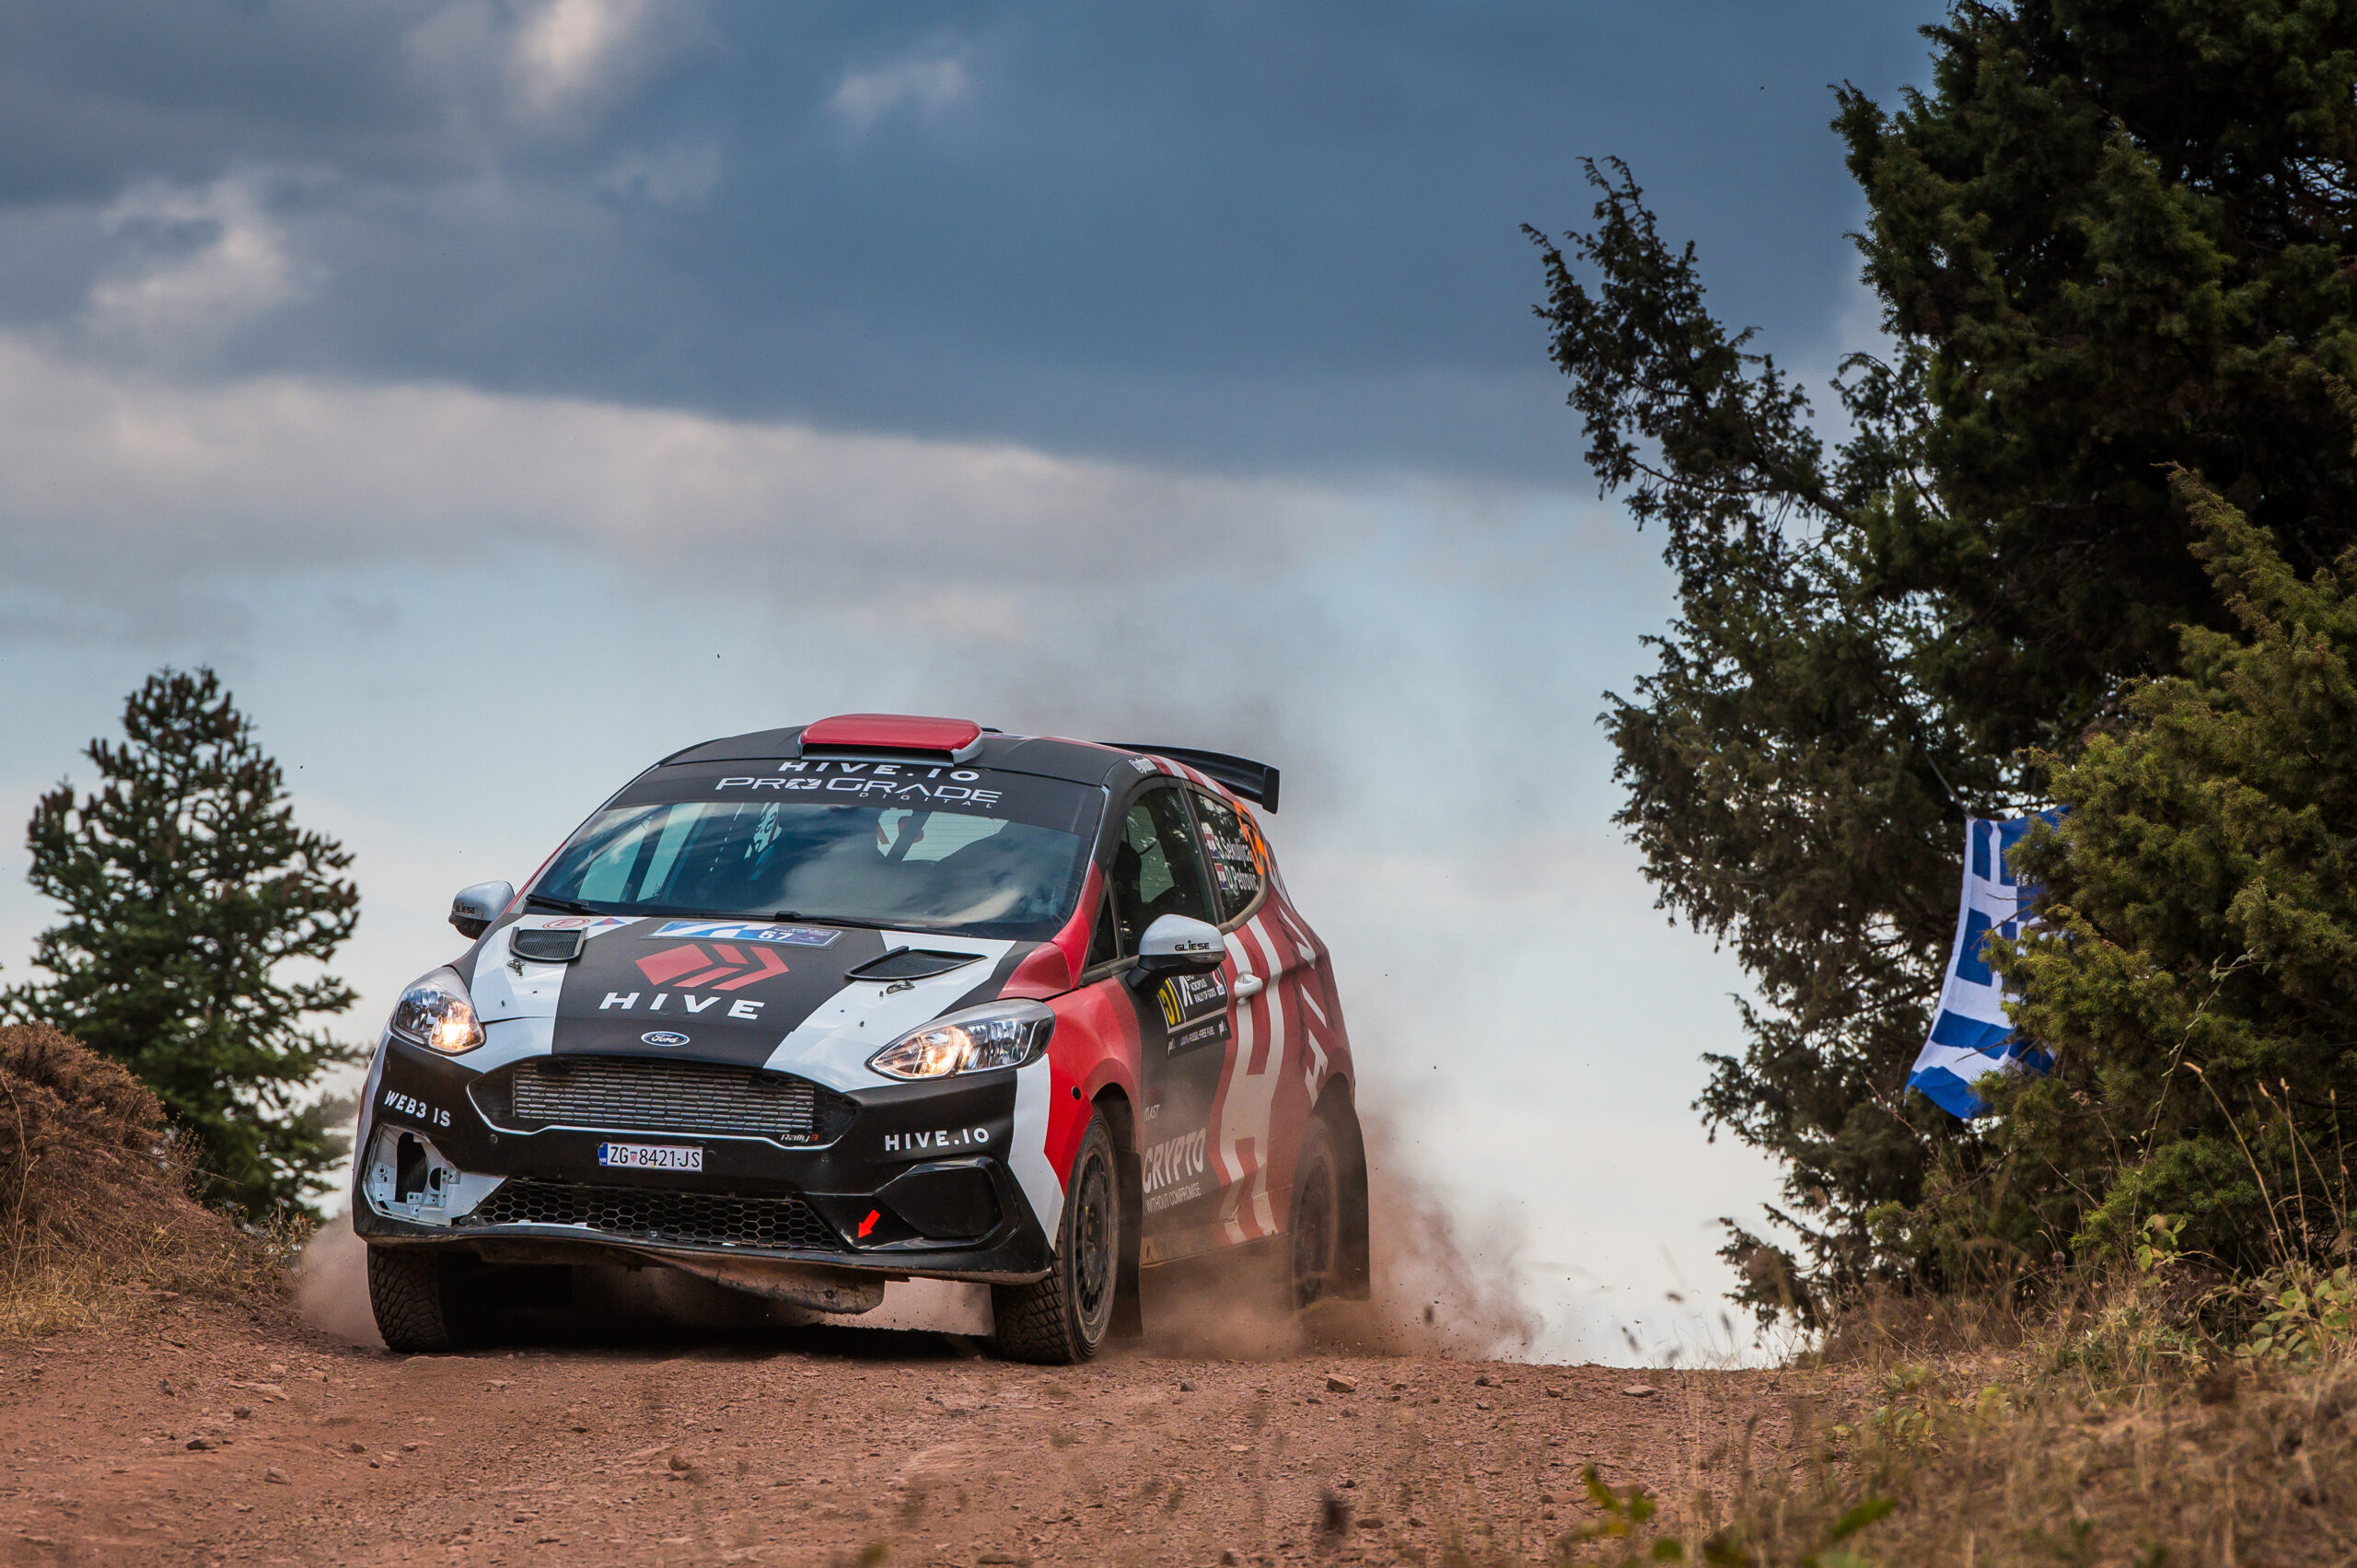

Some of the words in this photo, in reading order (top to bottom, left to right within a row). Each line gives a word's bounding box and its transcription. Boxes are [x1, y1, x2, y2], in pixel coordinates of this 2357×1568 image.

[777, 761, 981, 782] HIVE.IO
[858, 793, 993, 809] DIGITAL
[598, 992, 765, 1020] HIVE
[383, 1090, 427, 1119] WEB3
[433, 1107, 451, 1127] IS
[780, 1132, 819, 1144] Rally3
[885, 1127, 990, 1152] HIVE.IO
[610, 1146, 629, 1165] ZG
[639, 1148, 701, 1168] 8421-JS
[1142, 1127, 1207, 1194] CRYPTO
[1144, 1192, 1169, 1214] WITHOUT
[1168, 1182, 1202, 1206] COMPROMISE
